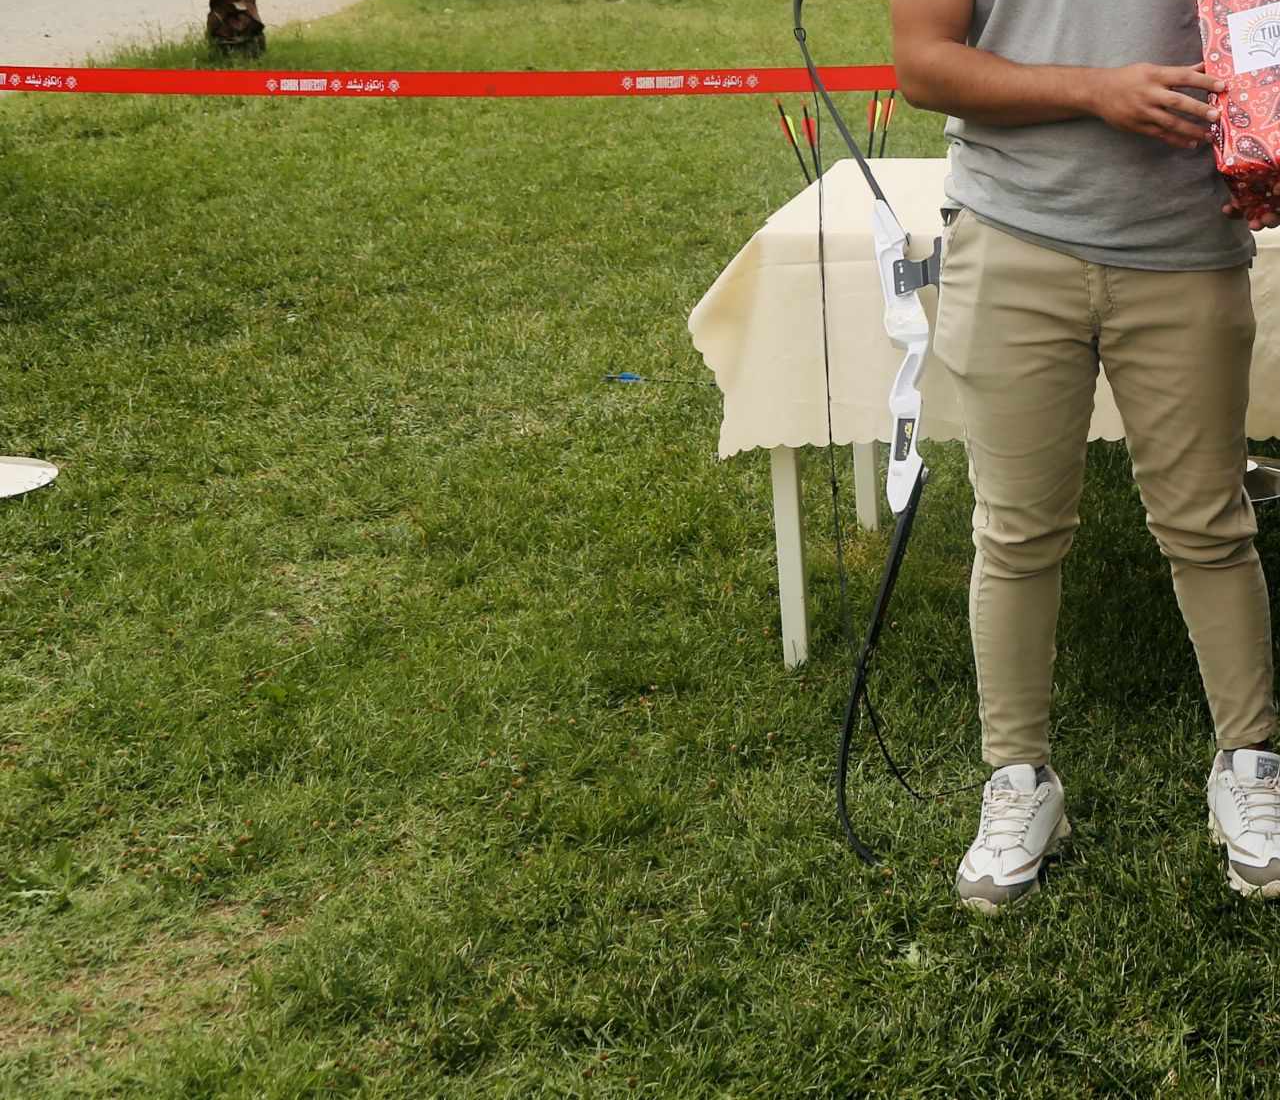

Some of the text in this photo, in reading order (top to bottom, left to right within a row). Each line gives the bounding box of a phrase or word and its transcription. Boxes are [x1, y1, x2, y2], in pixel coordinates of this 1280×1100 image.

[1260, 25, 1280, 40] TIU
[300, 79, 328, 91] UNIVERSITY
[655, 75, 684, 89] UNIVERSITY
